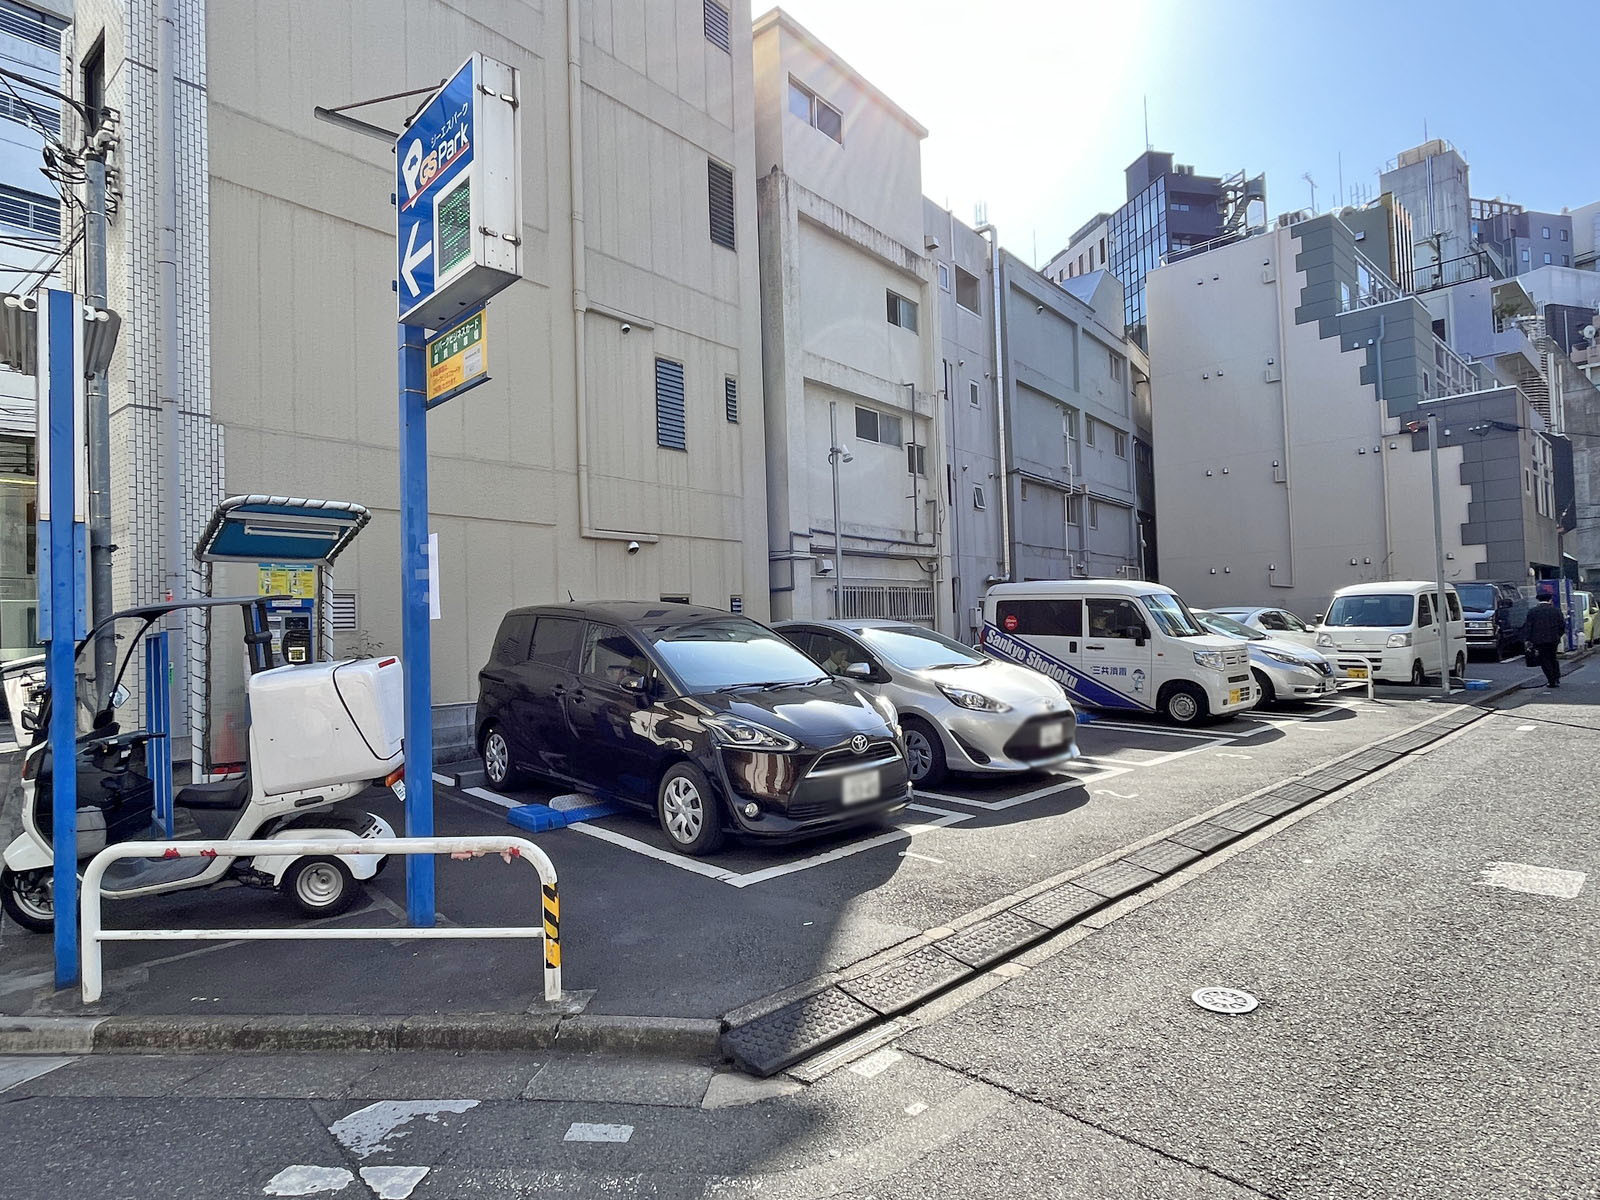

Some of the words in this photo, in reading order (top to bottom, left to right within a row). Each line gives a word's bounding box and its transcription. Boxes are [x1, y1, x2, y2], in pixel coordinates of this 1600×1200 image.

[431, 102, 469, 149] ジーエスパーク
[986, 629, 1027, 661] Sankyo
[1026, 651, 1079, 689] Shodoku
